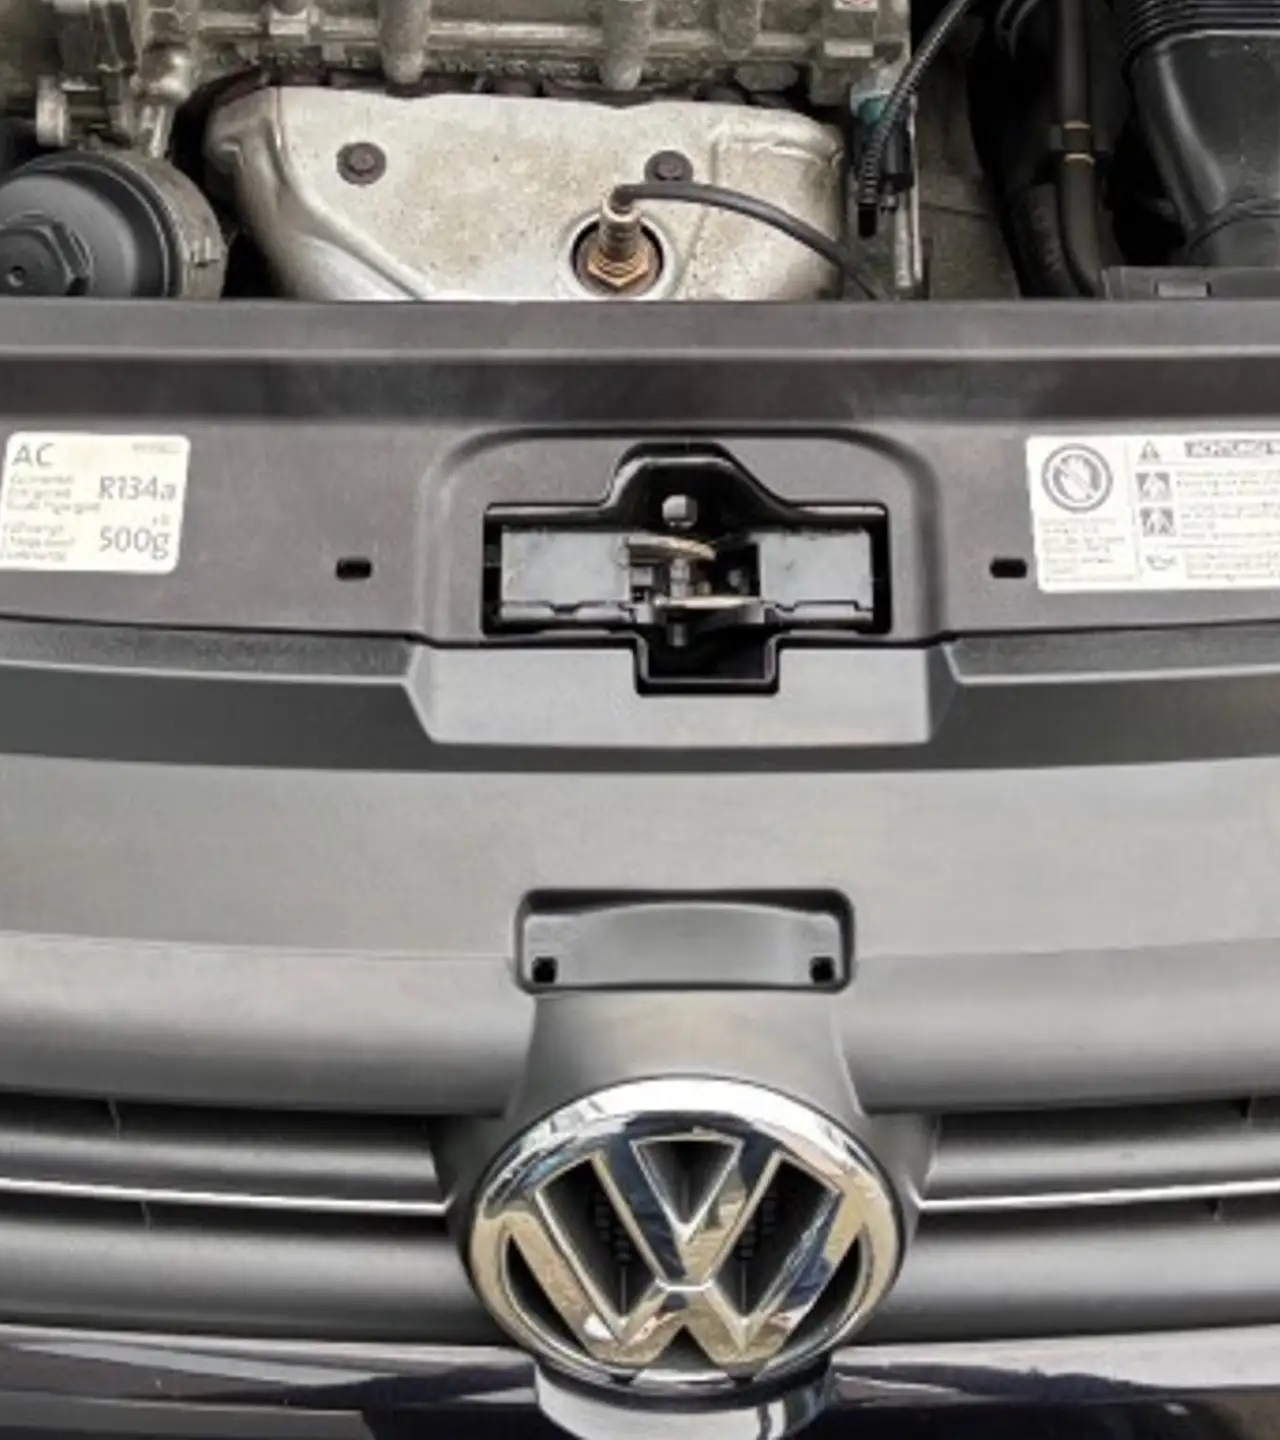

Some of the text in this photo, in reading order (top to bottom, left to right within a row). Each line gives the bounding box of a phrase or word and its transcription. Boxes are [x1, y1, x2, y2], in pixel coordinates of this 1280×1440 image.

[11, 442, 53, 467] AC
[99, 474, 177, 502] R134a
[99, 524, 171, 561] 500g
